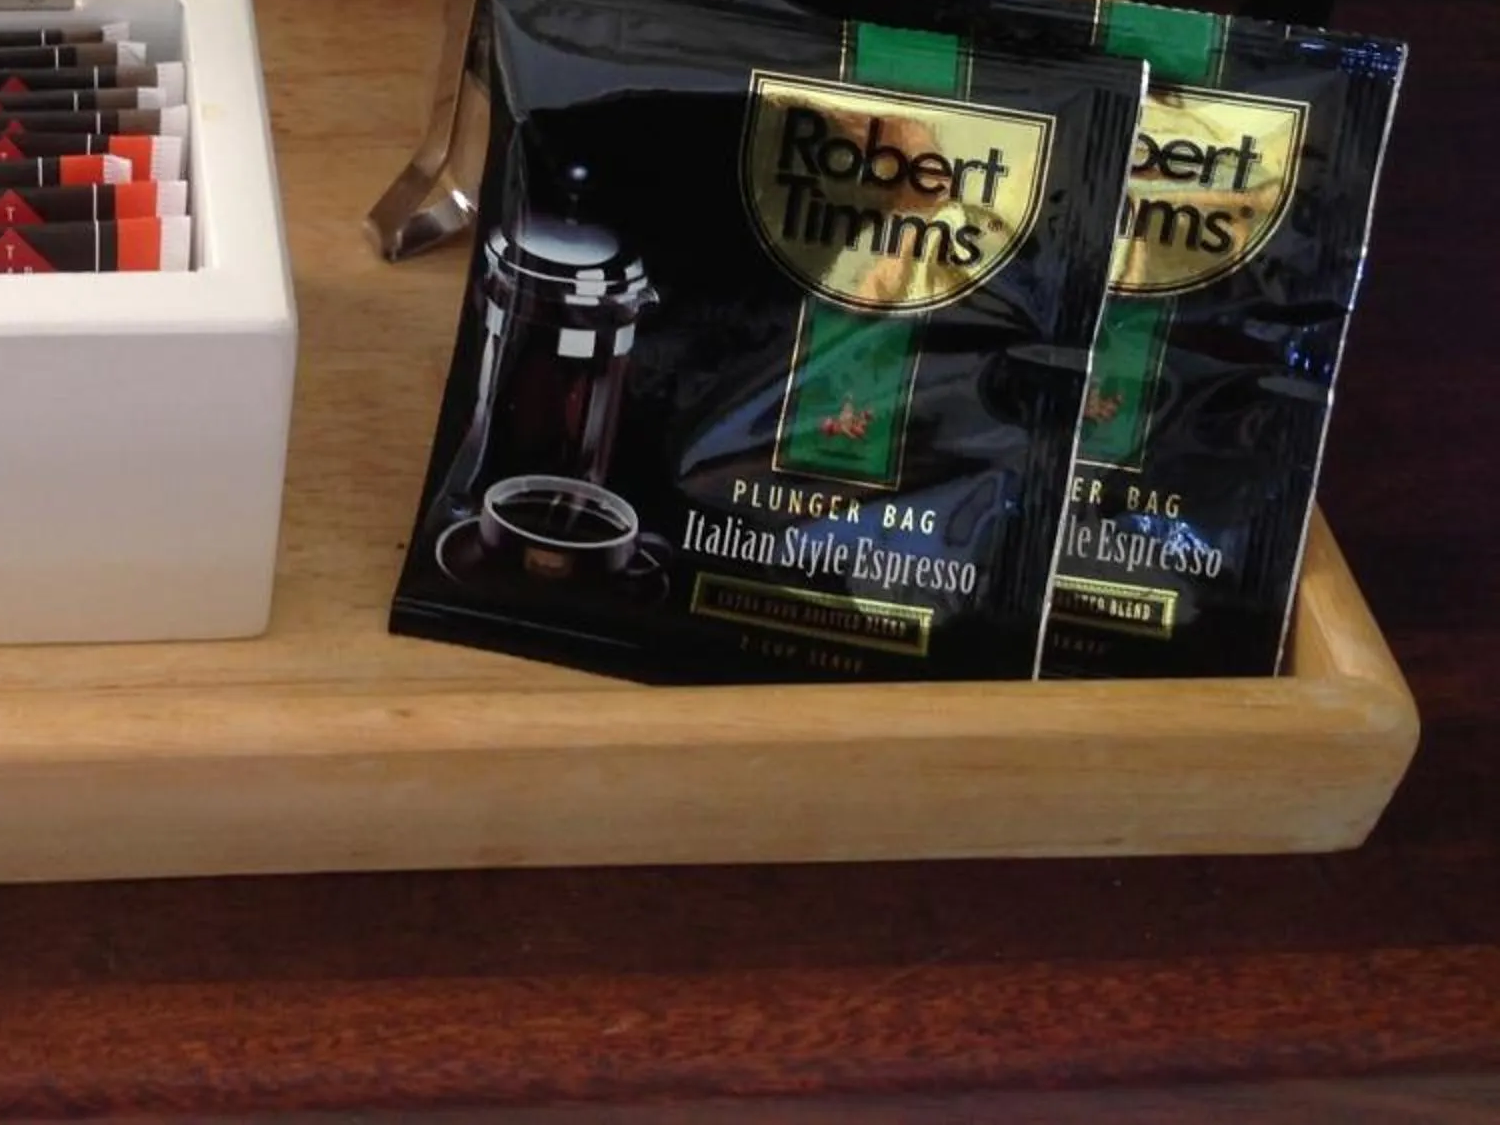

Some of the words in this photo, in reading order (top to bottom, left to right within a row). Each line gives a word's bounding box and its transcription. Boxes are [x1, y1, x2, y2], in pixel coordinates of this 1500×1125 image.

[777, 106, 1008, 206] Robert
[780, 177, 985, 267] Timms
[733, 479, 861, 525] PLUNGER
[883, 503, 938, 535] BAG
[1126, 485, 1183, 519] BAG
[682, 509, 776, 565] Italian
[781, 525, 849, 578] Style
[852, 536, 978, 595] Espresso
[1096, 518, 1223, 579] Espresso
